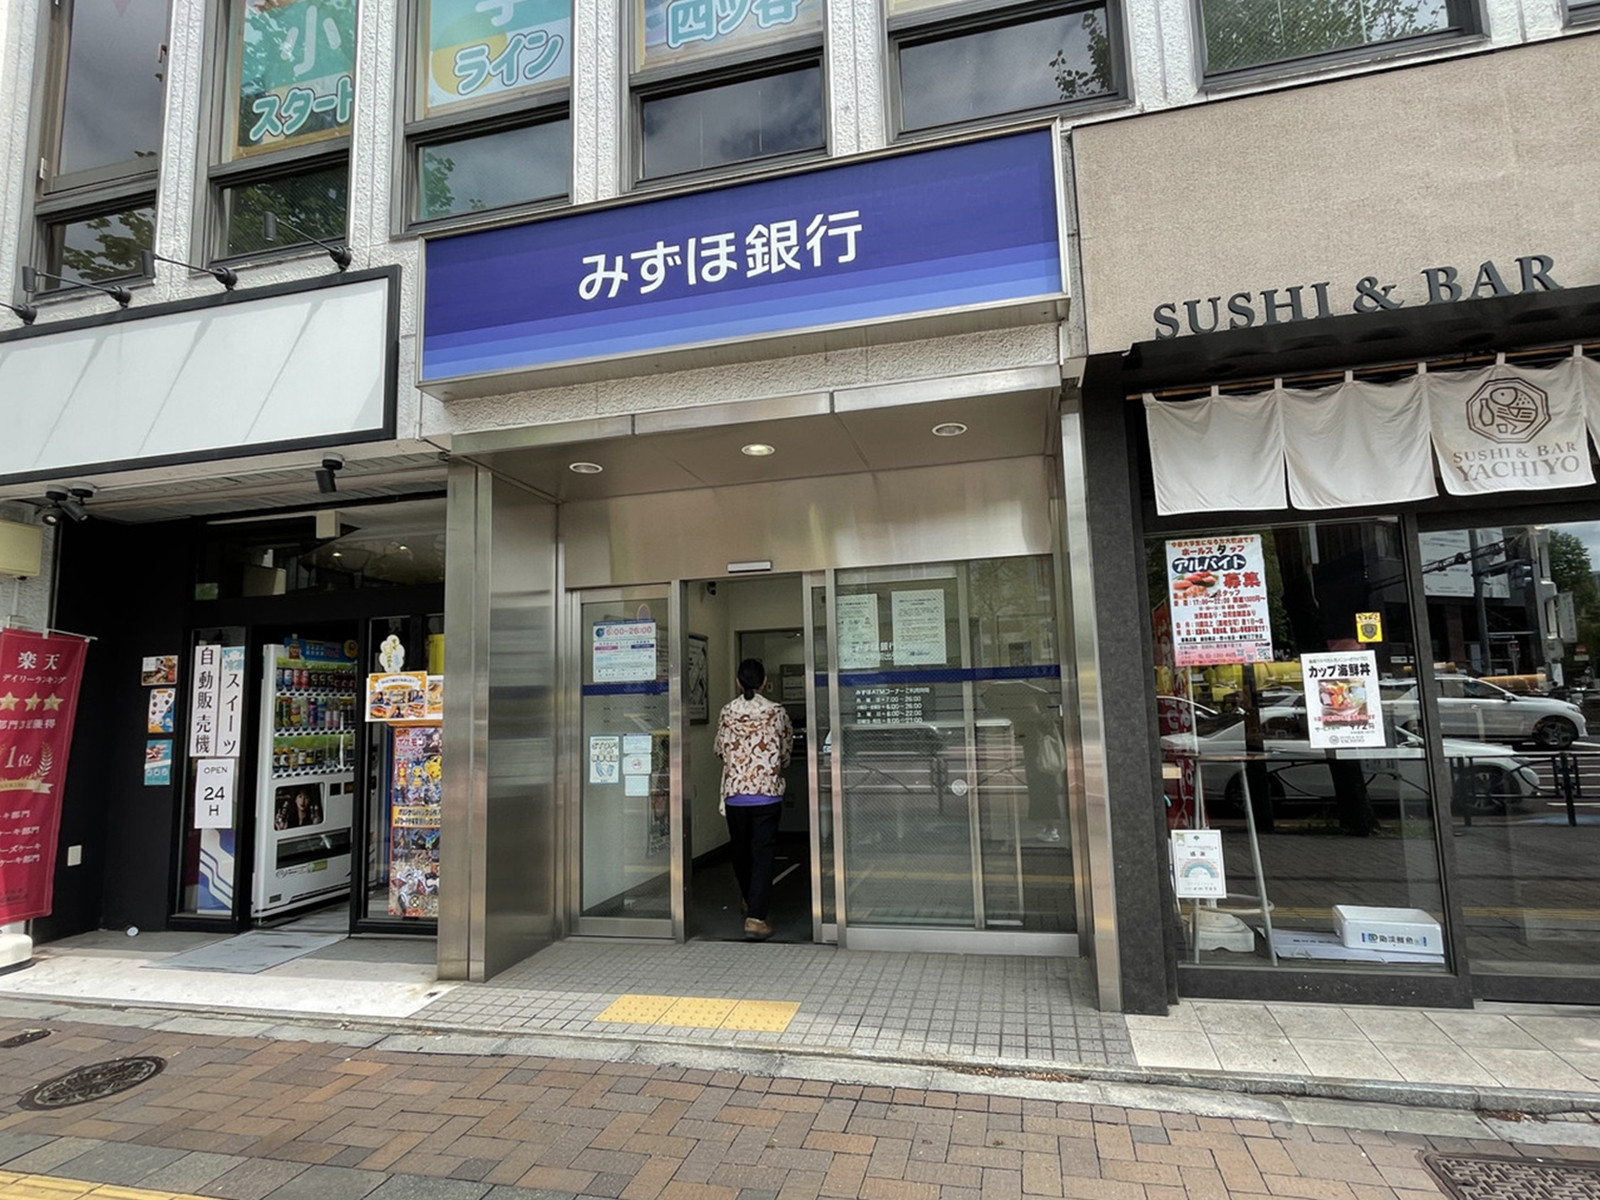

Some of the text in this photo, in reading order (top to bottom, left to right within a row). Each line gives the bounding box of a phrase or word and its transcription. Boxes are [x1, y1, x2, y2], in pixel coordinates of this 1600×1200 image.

[455, 29, 564, 96] ライン
[578, 209, 864, 301] みずほ銀行
[1153, 253, 1565, 342] SUSHI & BAR
[1453, 441, 1578, 464] SUSHI & BAR
[1456, 455, 1580, 482] YACHIYO
[1174, 555, 1246, 573] アルバイト
[17, 651, 60, 671] 楽天
[1308, 662, 1371, 678] カップ海鮮丼
[195, 647, 214, 754] 自動販売機
[223, 673, 241, 755] スイーツ
[203, 766, 228, 775] OPEN
[203, 786, 225, 801] 24
[209, 804, 219, 817] H
